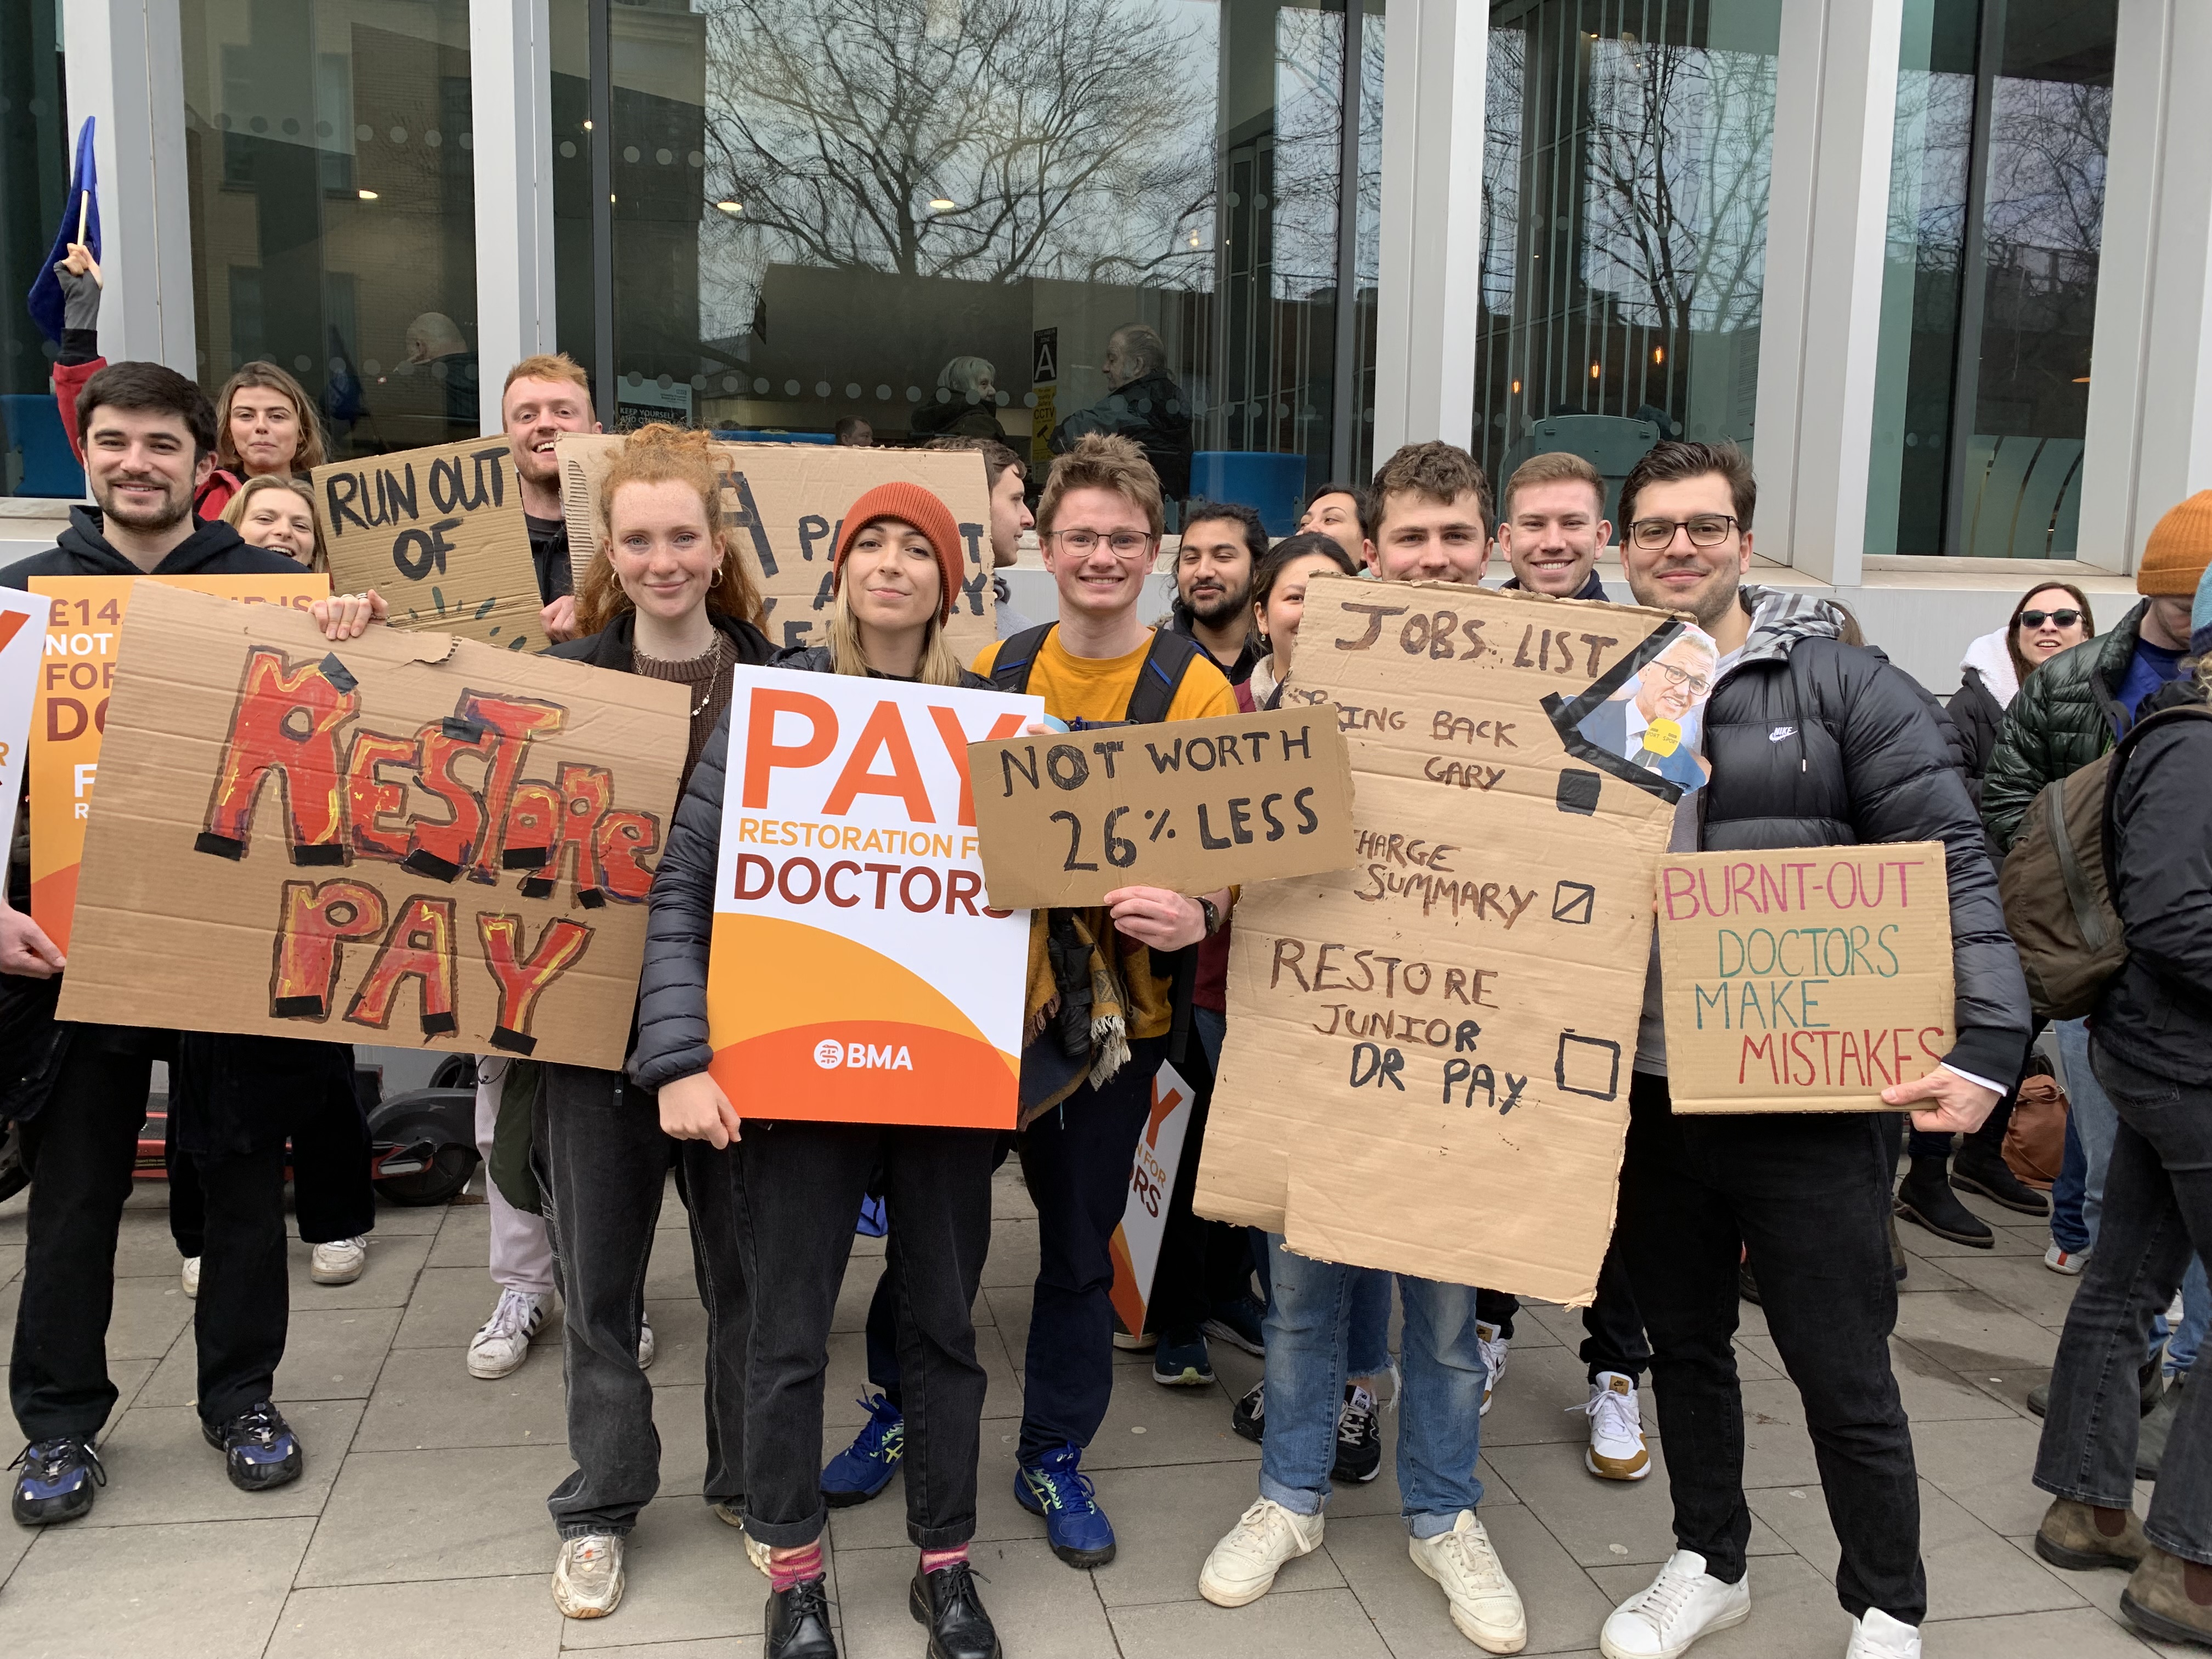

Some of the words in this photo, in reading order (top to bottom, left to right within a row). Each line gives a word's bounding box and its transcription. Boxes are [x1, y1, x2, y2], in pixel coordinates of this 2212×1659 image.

[1035, 344, 1056, 380] A
[639, 409, 674, 419] YOURSELF
[1034, 407, 1054, 419] CCTV
[326, 462, 420, 536] RUN
[428, 447, 511, 515] OUT
[392, 517, 464, 582] OF
[49, 599, 123, 626] £14
[46, 633, 113, 656] NOT
[1334, 601, 1486, 661] JOBS
[1513, 624, 1619, 678] LIST
[1429, 710, 1518, 748] BACK
[1774, 727, 1793, 736] NIKE
[742, 687, 1027, 827] PAY
[1001, 741, 1124, 797] NOT
[1145, 725, 1311, 774] WORTH
[1425, 756, 1505, 792] GARY
[738, 818, 951, 859] RESTORATION
[1049, 805, 1176, 871] 26%
[1197, 786, 1318, 850] LESS
[1353, 830, 1463, 872] HARGE
[1354, 864, 1537, 929] SUMMARY
[1663, 861, 1925, 921] BURNT-OUT
[269, 878, 595, 1057] PAY
[1271, 938, 1500, 1009] RESTORE
[1718, 924, 1899, 978] DOCTORS
[1312, 1003, 1481, 1053] JUNIOR
[1695, 980, 1830, 1030] MAKE
[847, 1045, 913, 1071] BMA
[1350, 1042, 1404, 1091] DR
[1443, 1059, 1527, 1115] PAY
[1739, 1027, 1944, 1086] MISTAKES
[1143, 1150, 1166, 1188] FOR
